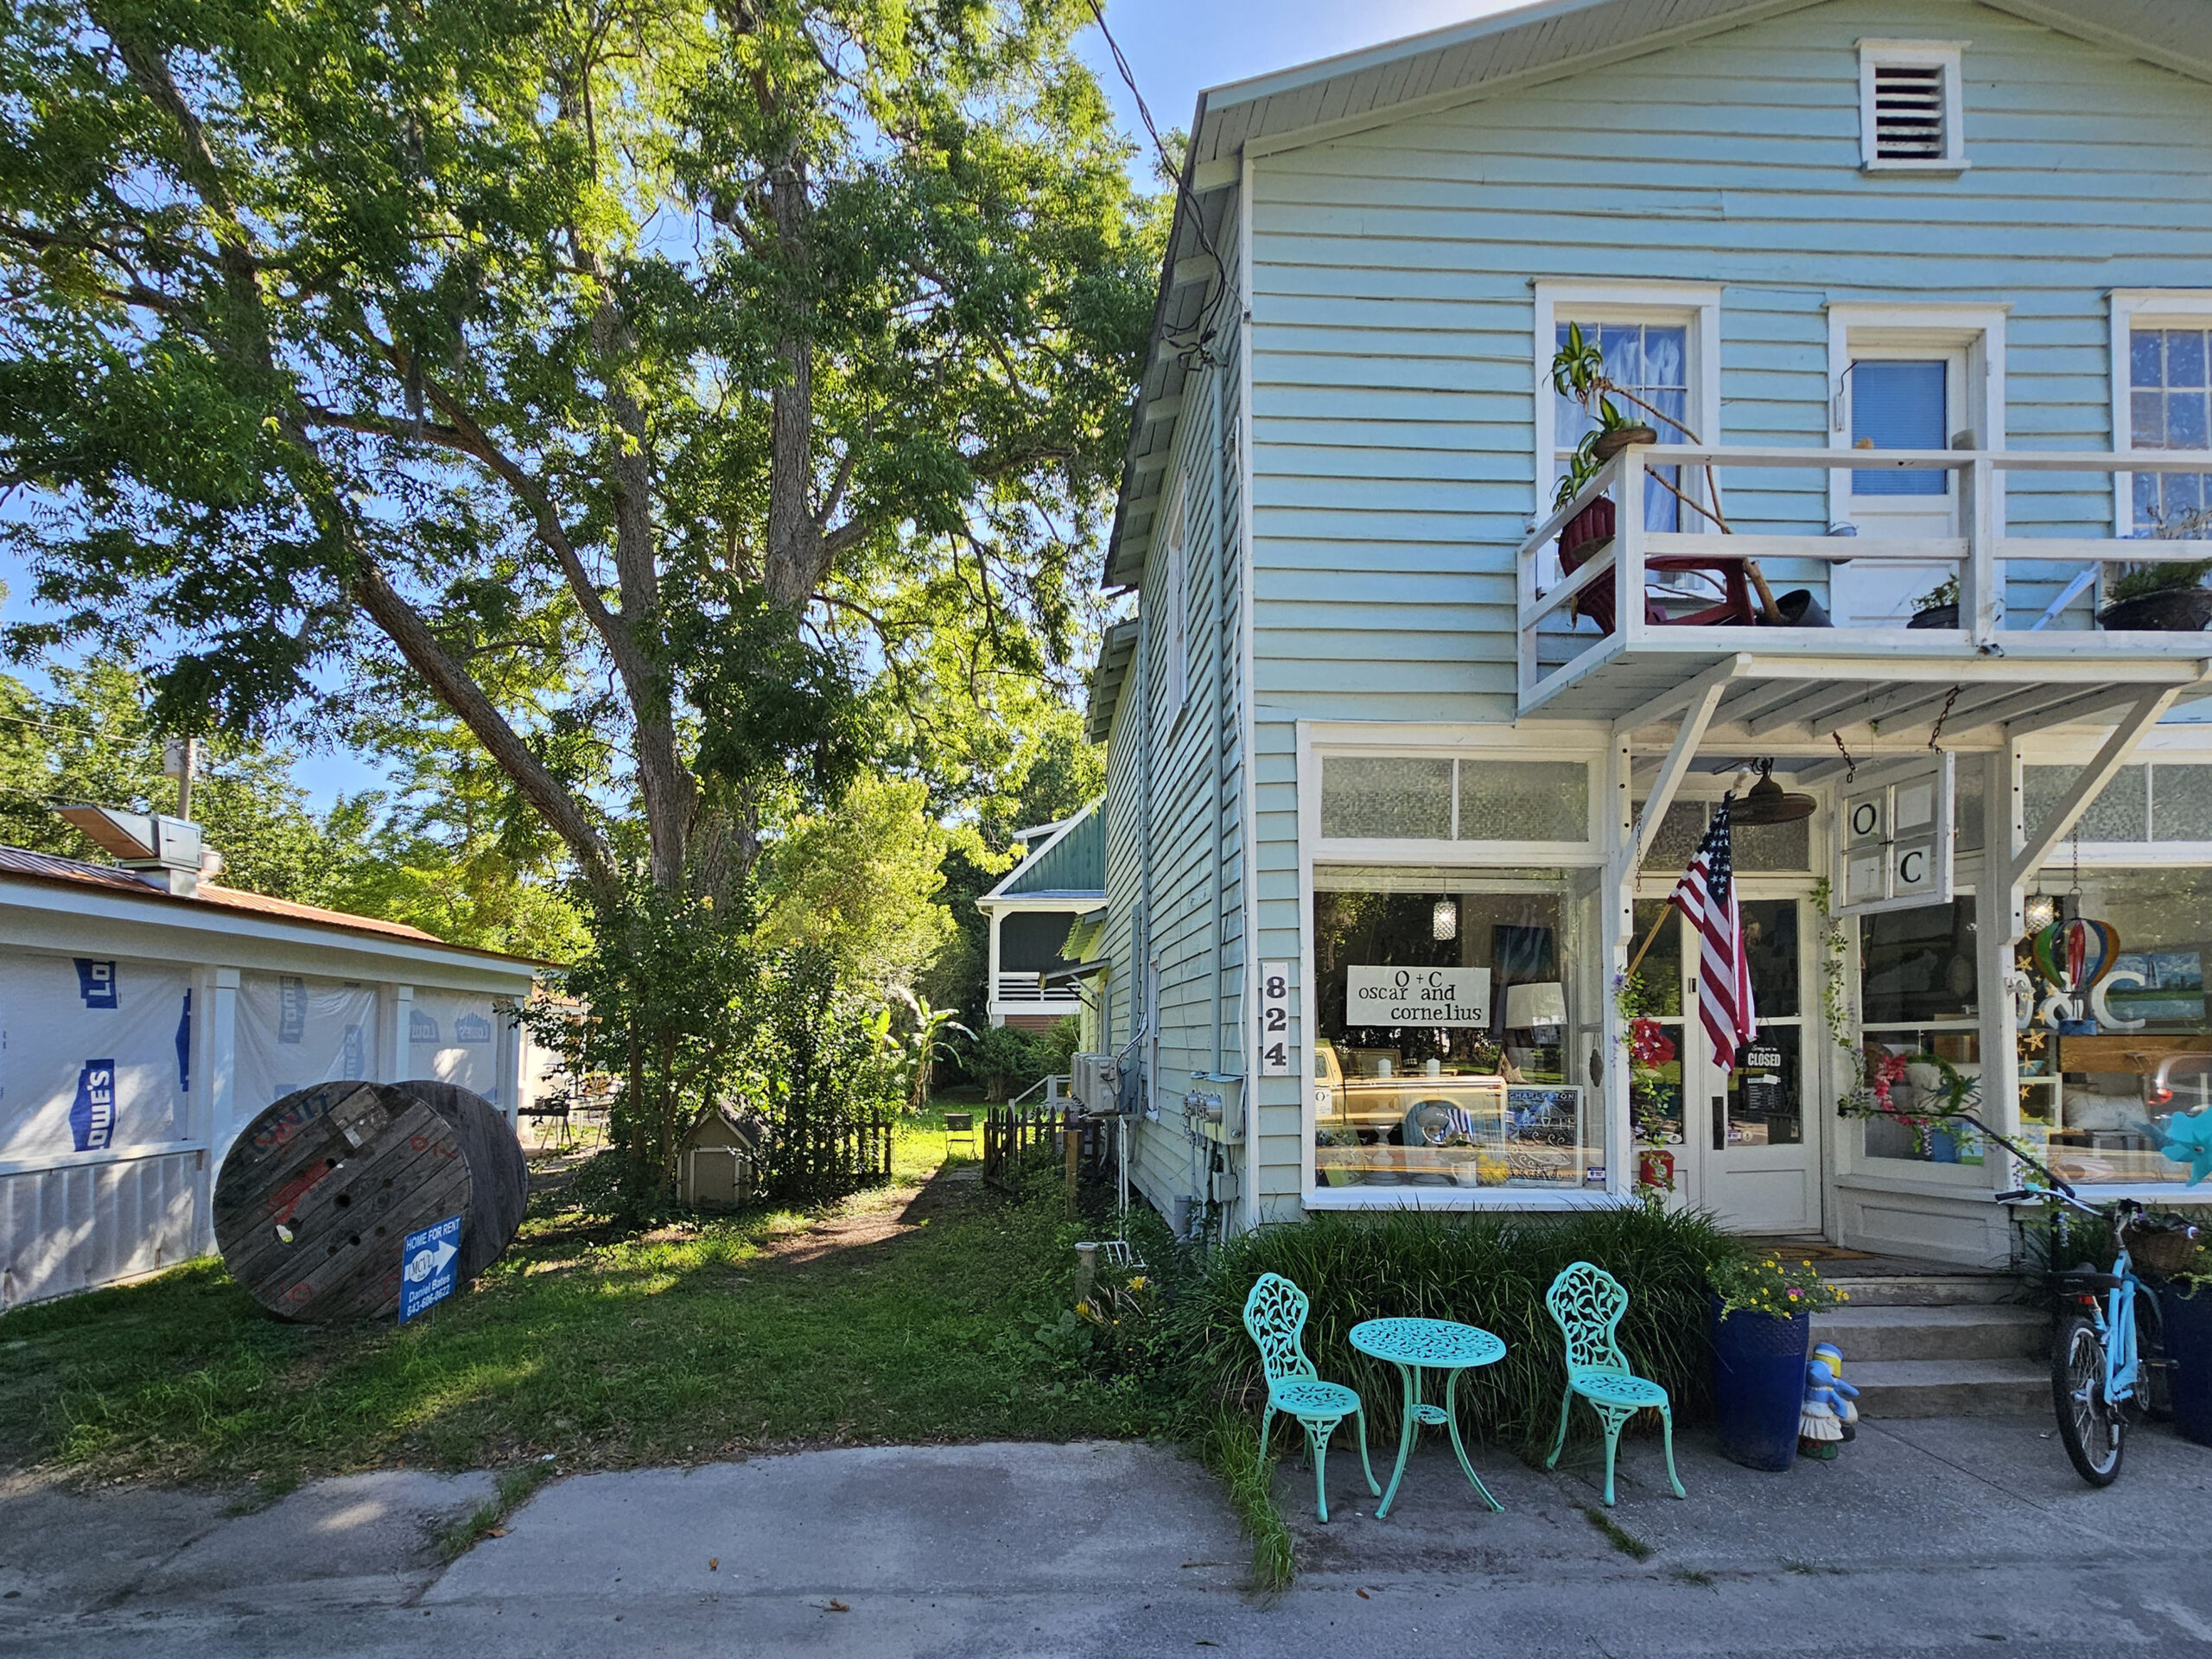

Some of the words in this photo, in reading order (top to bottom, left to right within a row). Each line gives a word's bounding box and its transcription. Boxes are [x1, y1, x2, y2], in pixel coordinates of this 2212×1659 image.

[1853, 804, 1877, 835] O
[1901, 851, 1923, 883] C
[1358, 987, 1408, 1000] oscar
[1421, 984, 1456, 1001] and
[1395, 970, 1410, 987] O
[1428, 971, 1442, 988] C
[1391, 1003, 1482, 1020] cornelius
[2091, 970, 2145, 1029] C
[1748, 1052, 1781, 1066] CLOSED
[87, 1070, 111, 1149] OWE'S
[406, 1232, 428, 1251] HOME
[428, 1226, 442, 1243] FOR
[442, 1217, 461, 1236] RENT
[409, 1282, 431, 1303] Daniel
[432, 1274, 450, 1290] Bates
